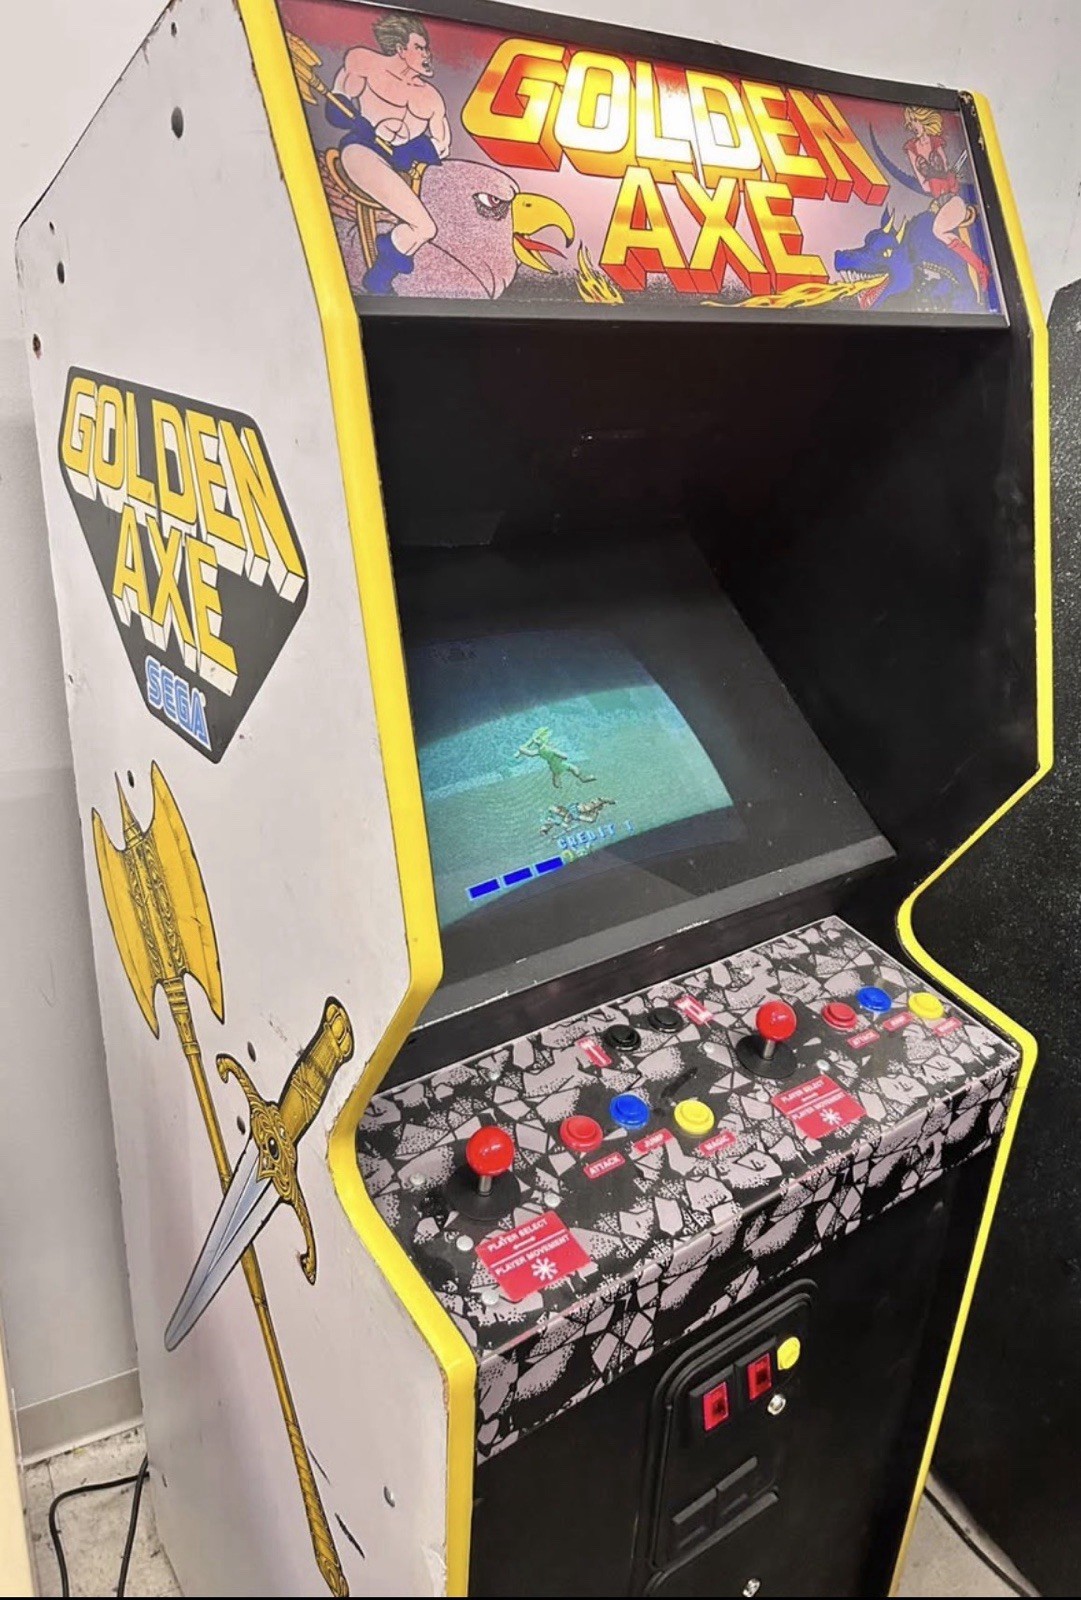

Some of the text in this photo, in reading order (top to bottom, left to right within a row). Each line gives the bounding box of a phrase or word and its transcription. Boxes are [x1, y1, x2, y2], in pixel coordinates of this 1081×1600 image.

[461, 38, 891, 207] GOLDEN
[599, 165, 830, 294] AXE
[62, 376, 307, 603] GOLDEN
[112, 502, 239, 697] AXE
[145, 655, 212, 752] SEGA
[558, 823, 616, 850] CREDIT
[588, 1155, 620, 1176] ATTACK
[487, 1217, 548, 1253] PLAYER SELECT
[494, 1233, 570, 1276] PLAYER MOVEMENT
